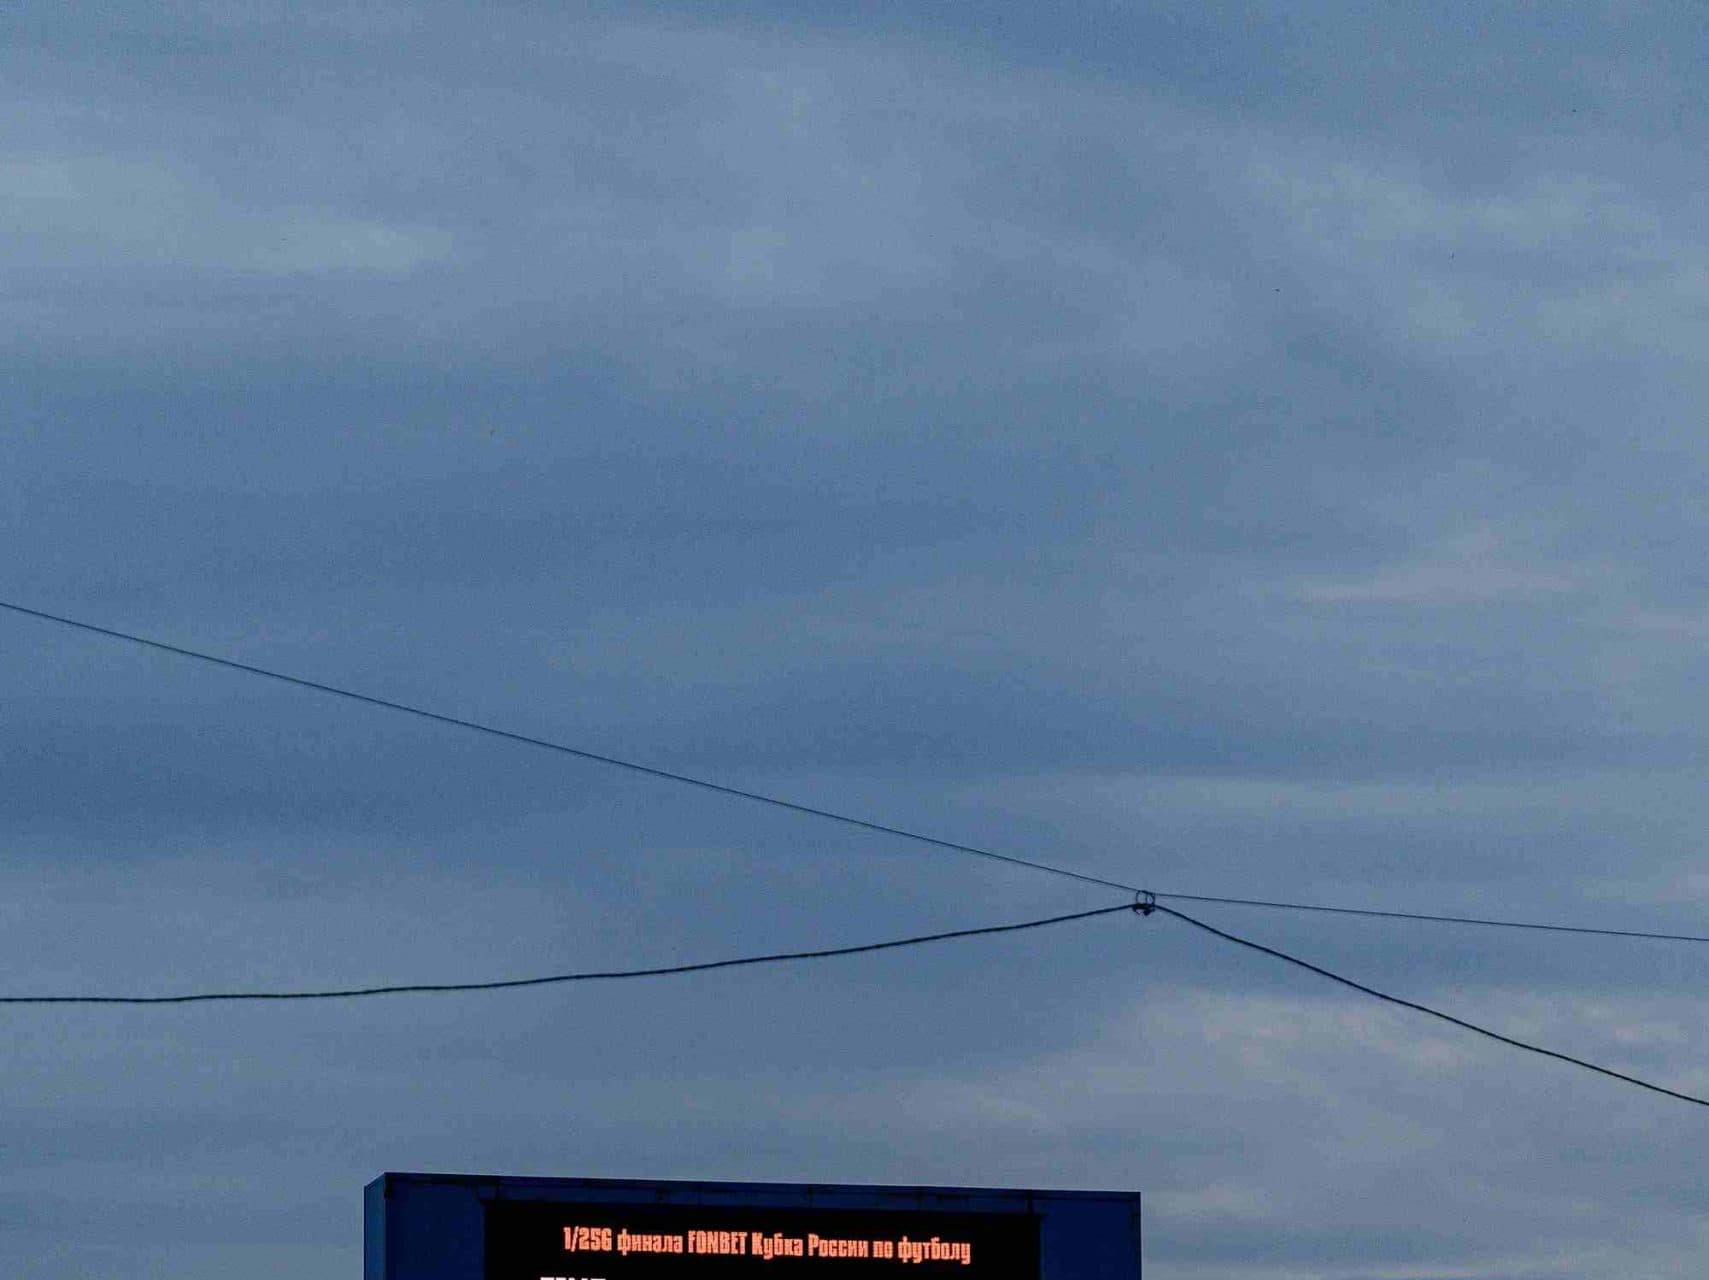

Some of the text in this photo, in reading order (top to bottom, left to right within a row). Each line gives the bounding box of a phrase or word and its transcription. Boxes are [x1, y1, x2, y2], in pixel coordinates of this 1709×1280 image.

[563, 1226, 971, 1265] 1/256 финала FONBET Кубка России по футболу
